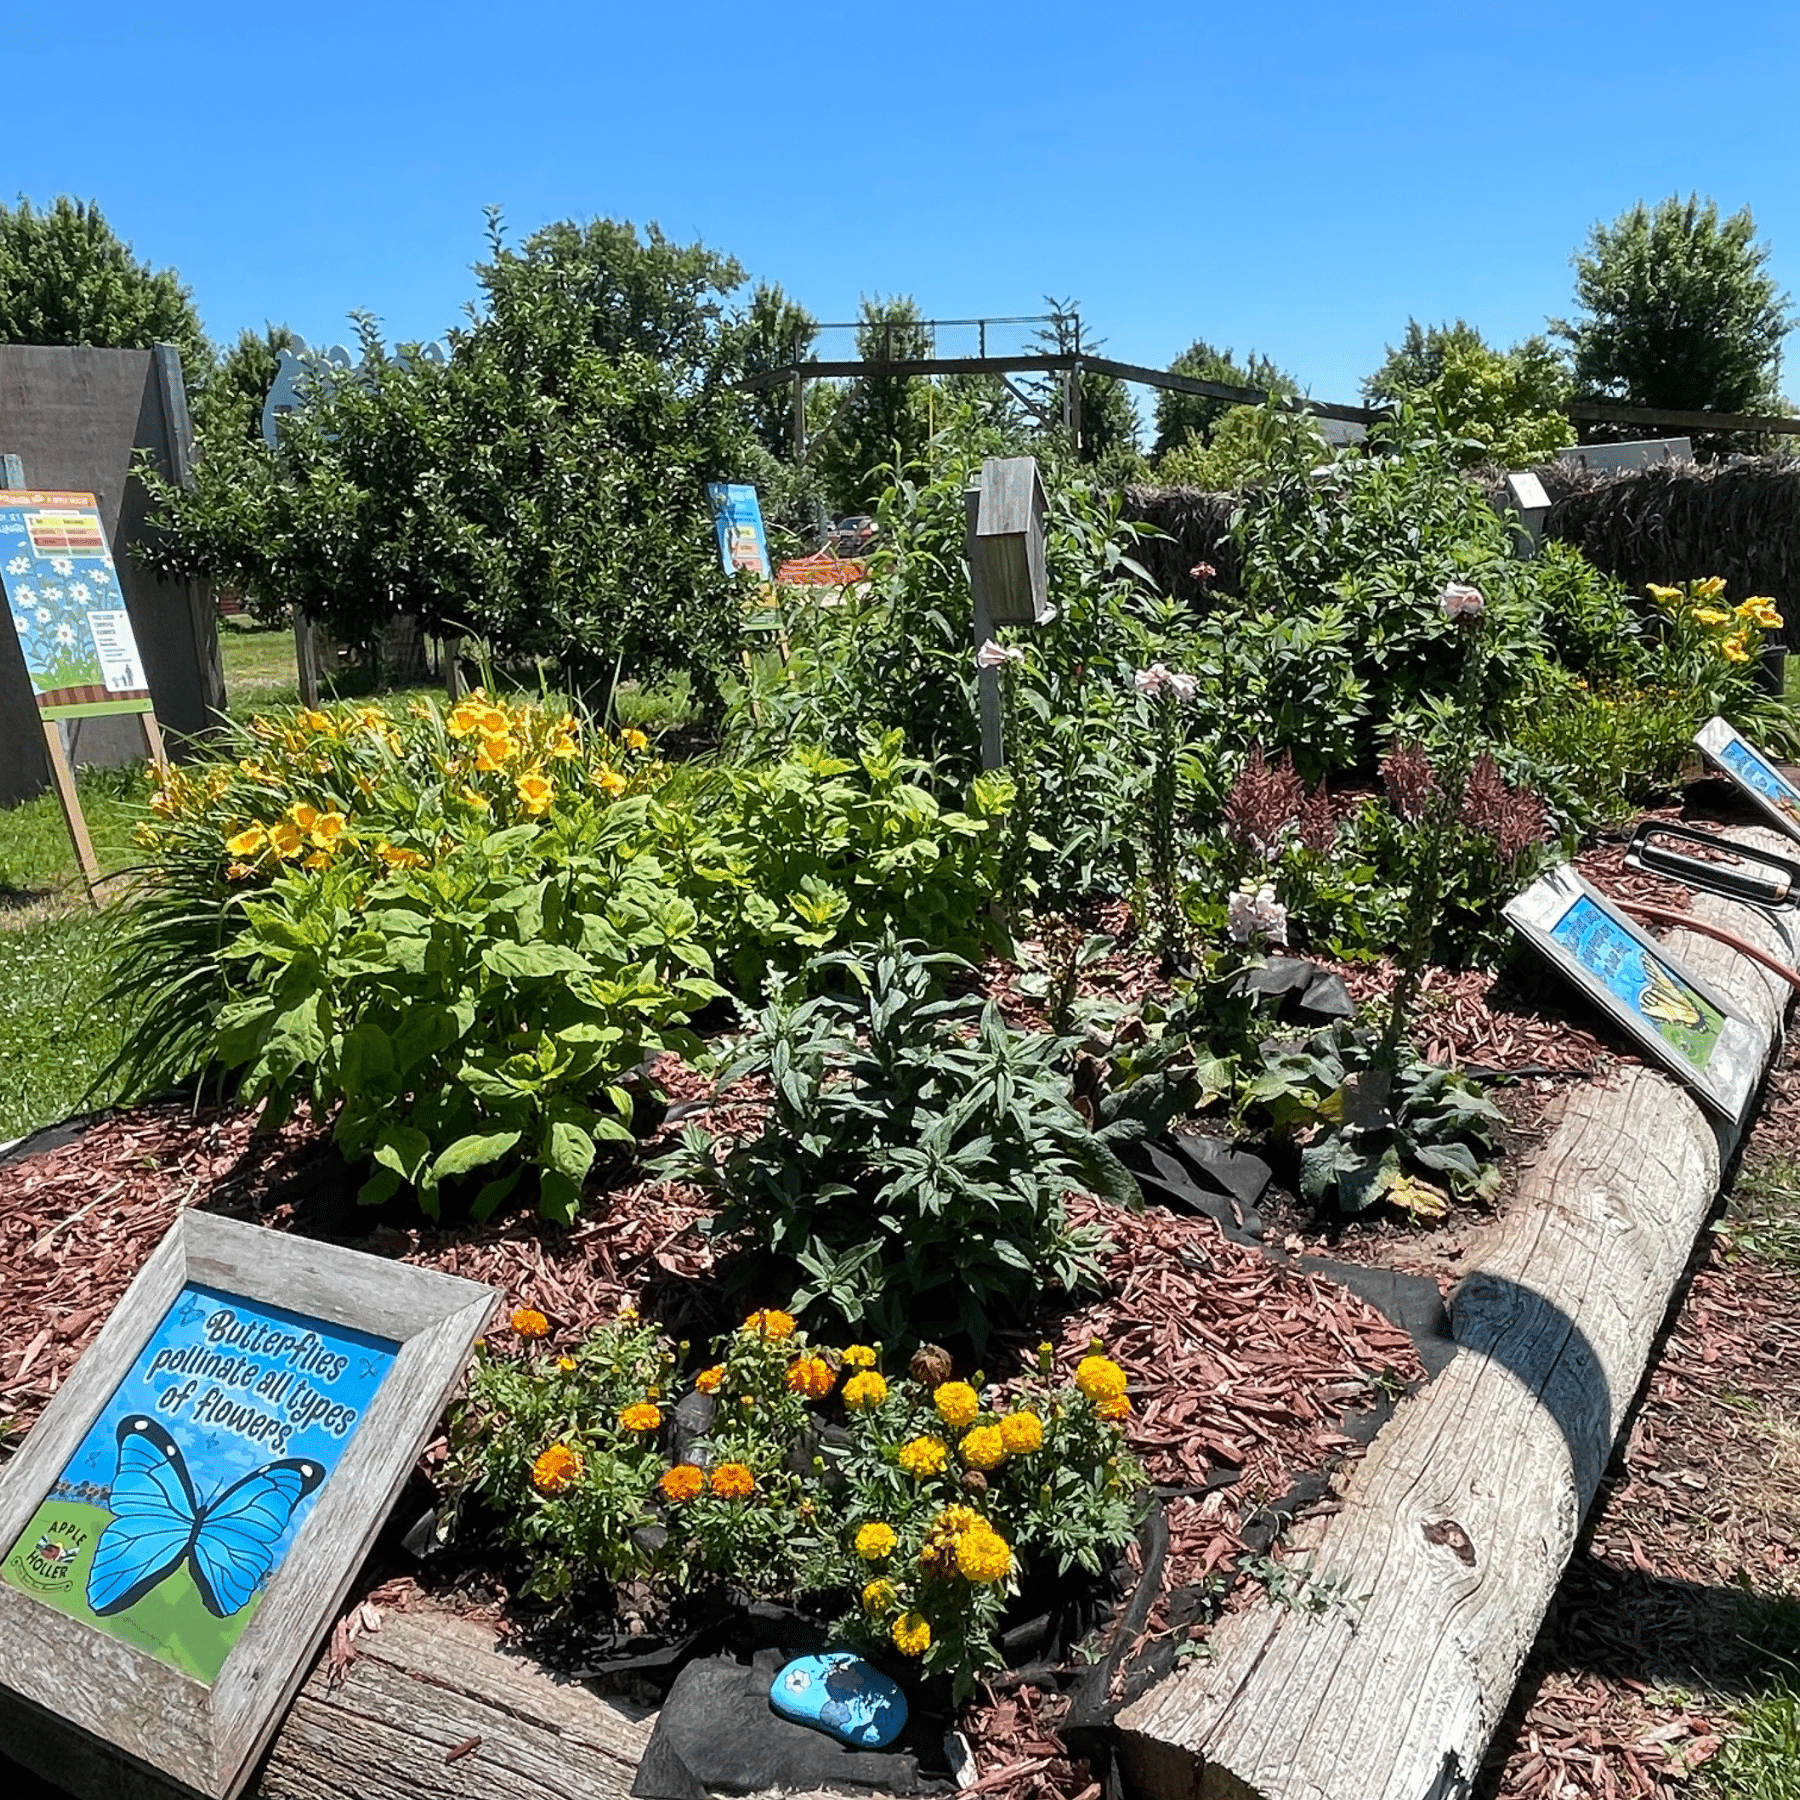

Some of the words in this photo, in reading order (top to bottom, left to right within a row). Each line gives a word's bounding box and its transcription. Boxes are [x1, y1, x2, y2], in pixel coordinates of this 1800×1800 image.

[206, 1309, 348, 1382] Butterflies
[146, 1345, 260, 1387] pollinate
[256, 1371, 295, 1404] all
[286, 1379, 356, 1436] types
[158, 1379, 198, 1413] of
[193, 1386, 293, 1455] flowers.
[26, 1550, 69, 1579] HOLLER
[47, 1521, 88, 1547] APPLE
